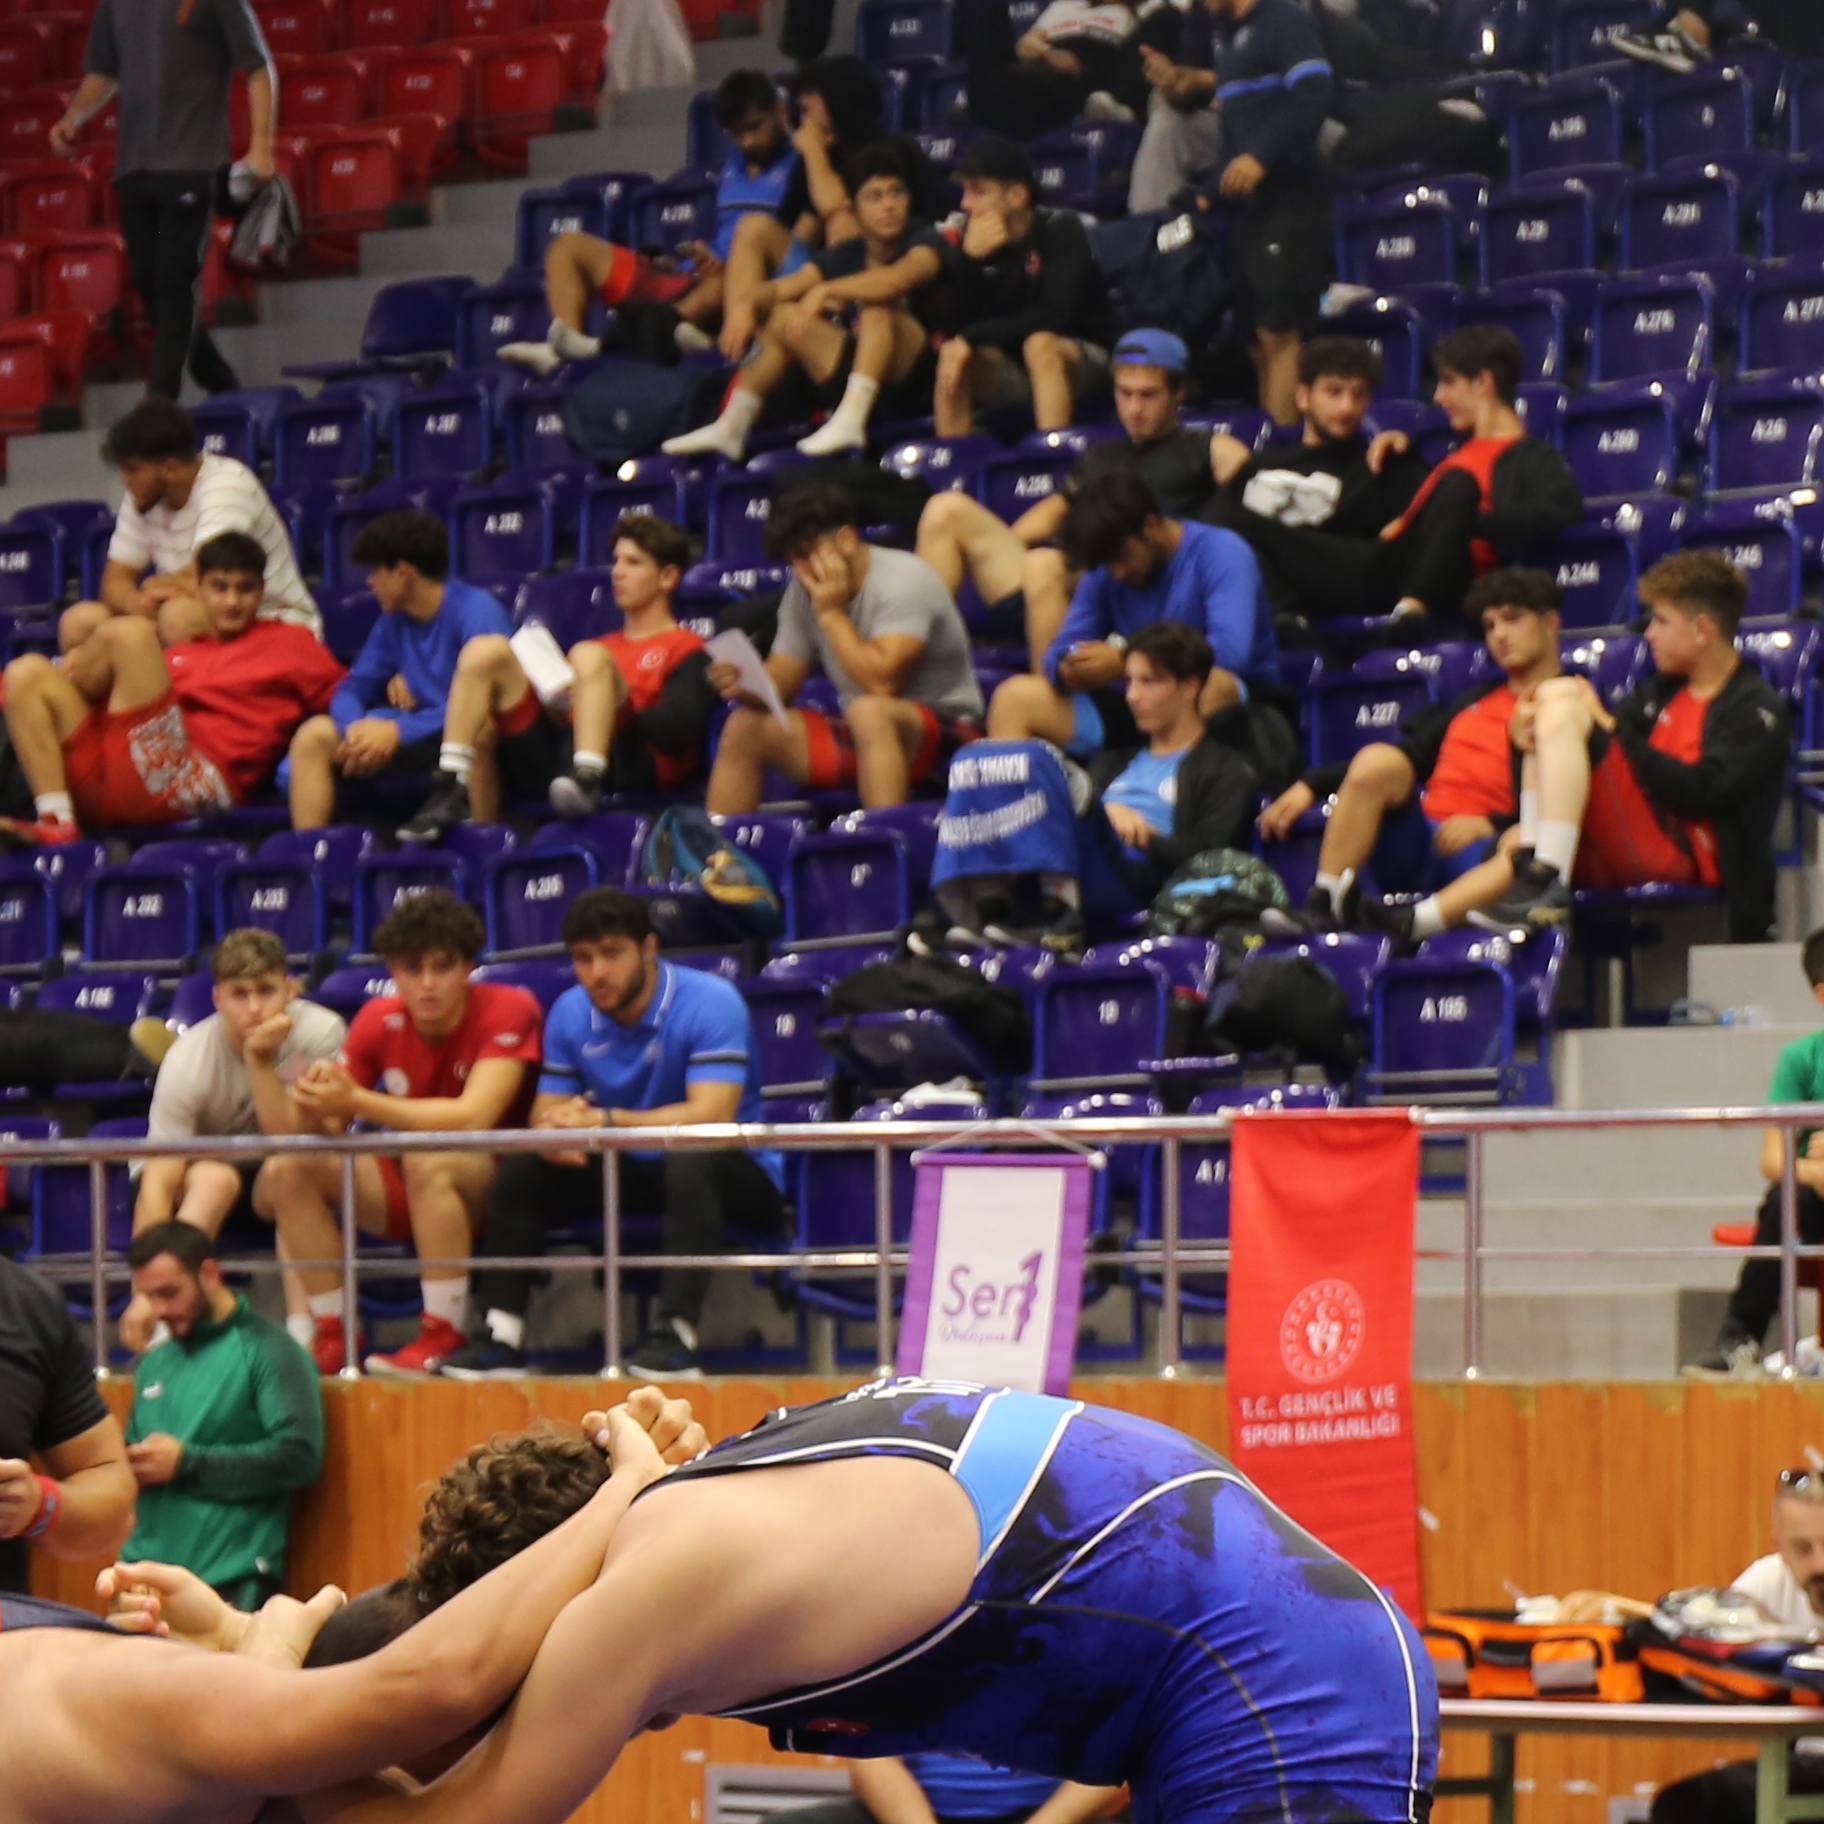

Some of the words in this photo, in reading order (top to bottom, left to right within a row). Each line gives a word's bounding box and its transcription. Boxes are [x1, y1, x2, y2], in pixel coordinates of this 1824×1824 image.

[1238, 1396, 1276, 1420] T.C.
[1278, 1386, 1367, 1419] GENÇLİK
[1369, 1384, 1398, 1409] VE
[1240, 1421, 1294, 1449] SPOR
[1295, 1412, 1401, 1447] BAKANLIĞI
